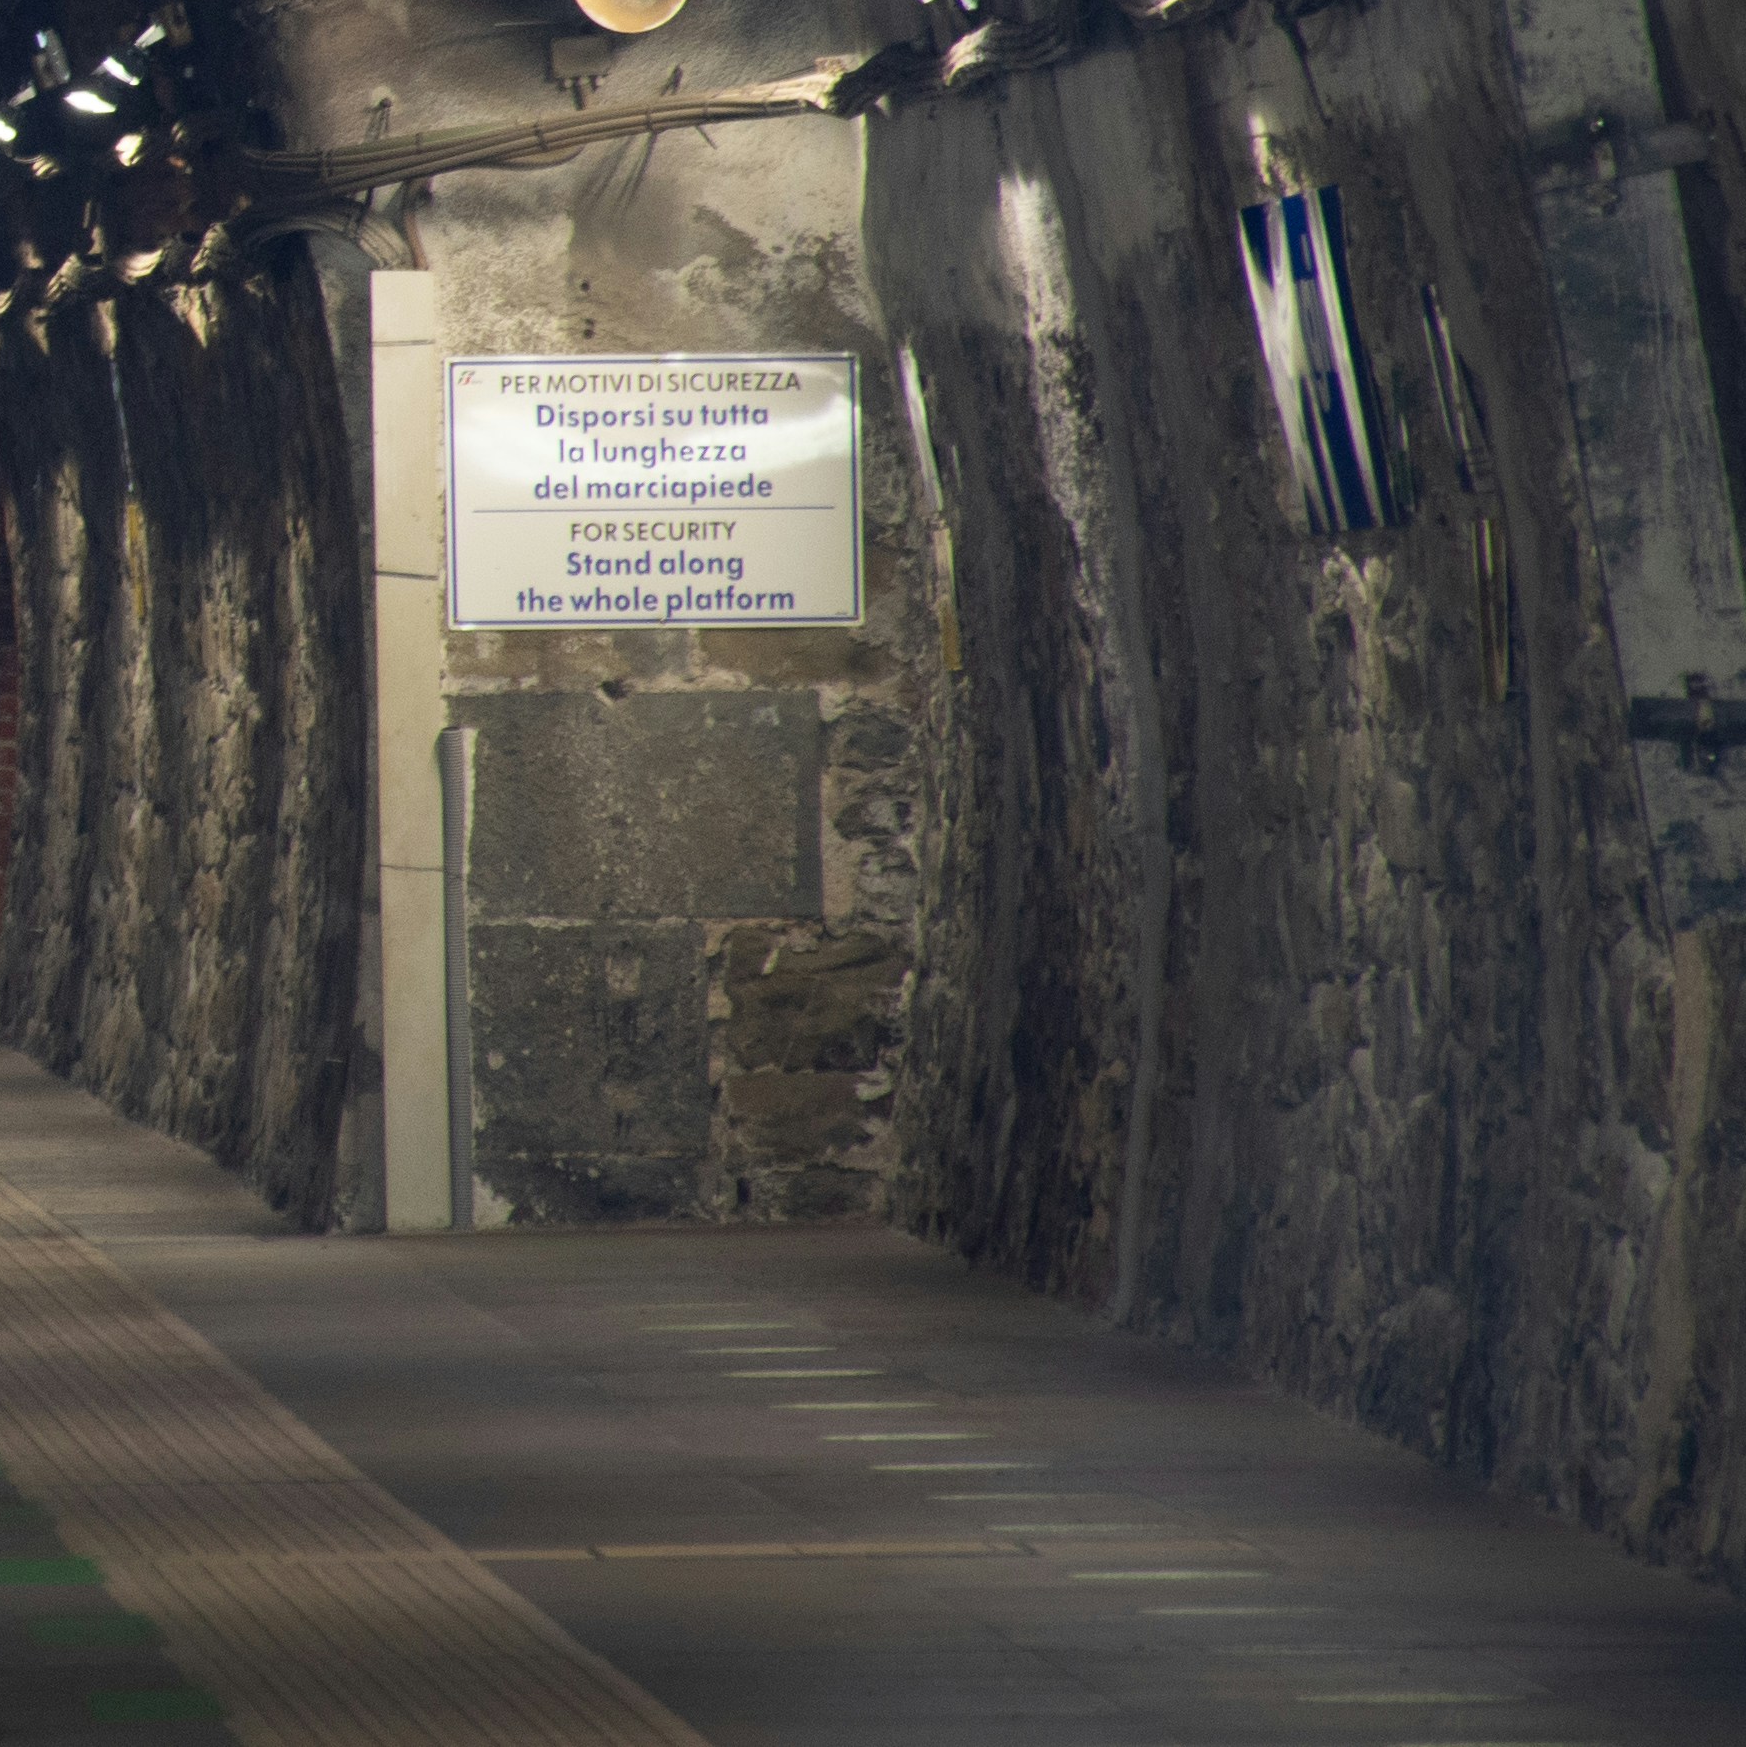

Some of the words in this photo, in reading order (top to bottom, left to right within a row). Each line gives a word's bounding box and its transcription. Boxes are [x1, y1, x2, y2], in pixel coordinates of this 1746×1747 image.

[500, 375, 539, 394] PER
[546, 374, 634, 393] MOTIVI
[639, 374, 663, 392] DI
[668, 372, 801, 392] SICUREZZA
[537, 403, 655, 432] Disporsi
[663, 407, 690, 425] su
[700, 404, 768, 425] tutta
[559, 439, 584, 463] la
[593, 438, 746, 468] lunghezza
[535, 475, 577, 500] del
[587, 473, 773, 504] marciapiede
[571, 522, 616, 541] FOR
[623, 521, 736, 541] SECURITY
[566, 551, 650, 576] Stand
[659, 550, 744, 580] along
[517, 588, 563, 611] the
[570, 587, 658, 611] whole
[666, 584, 794, 617] platform
